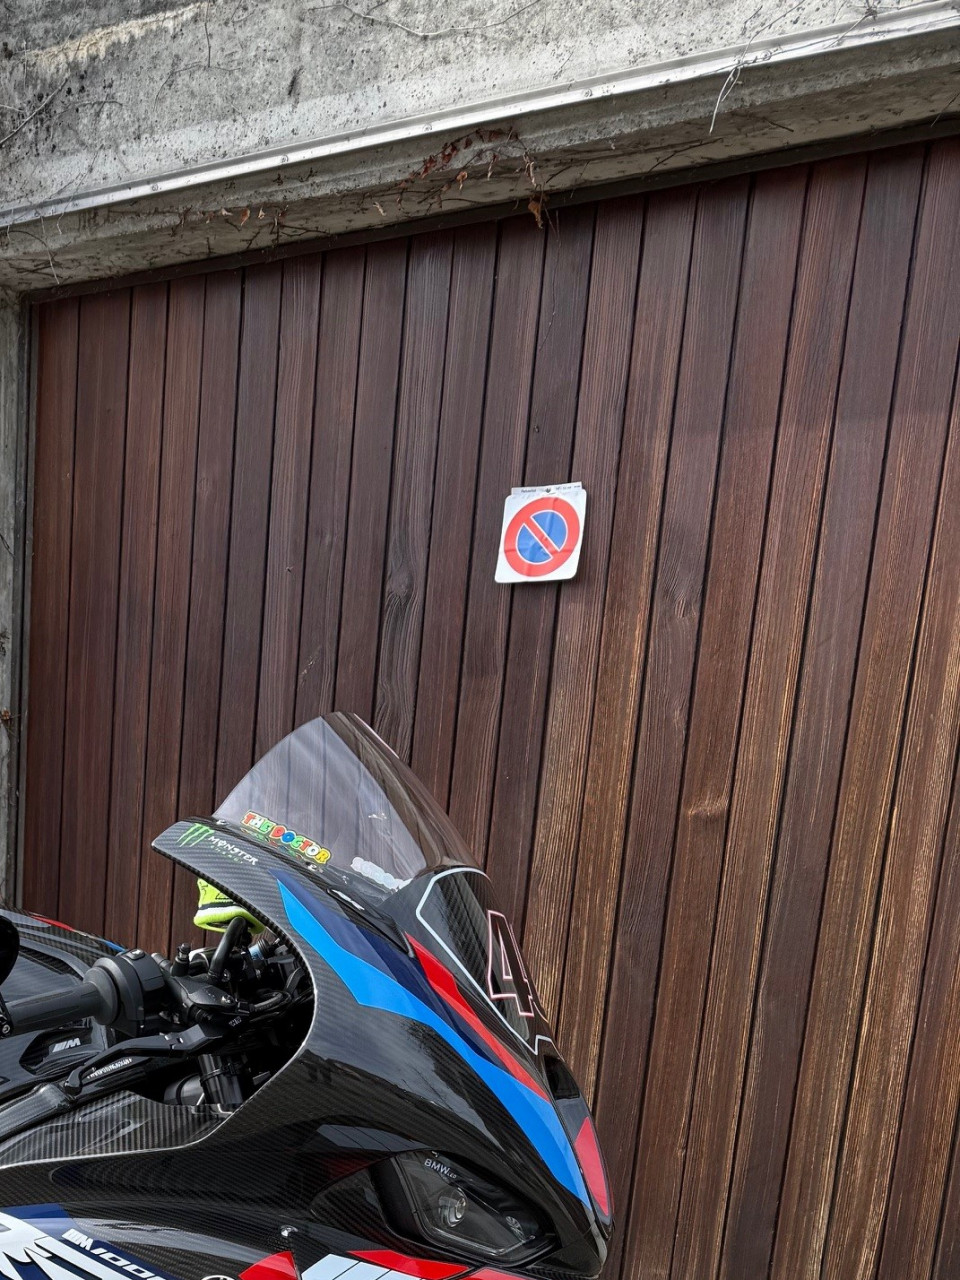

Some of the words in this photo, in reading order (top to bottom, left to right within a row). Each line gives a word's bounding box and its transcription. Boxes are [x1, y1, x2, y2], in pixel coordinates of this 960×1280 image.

[208, 836, 258, 865] MONSTER
[243, 812, 274, 833] THE
[271, 825, 330, 863] DOCTOR
[424, 1158, 450, 1174] BMW
